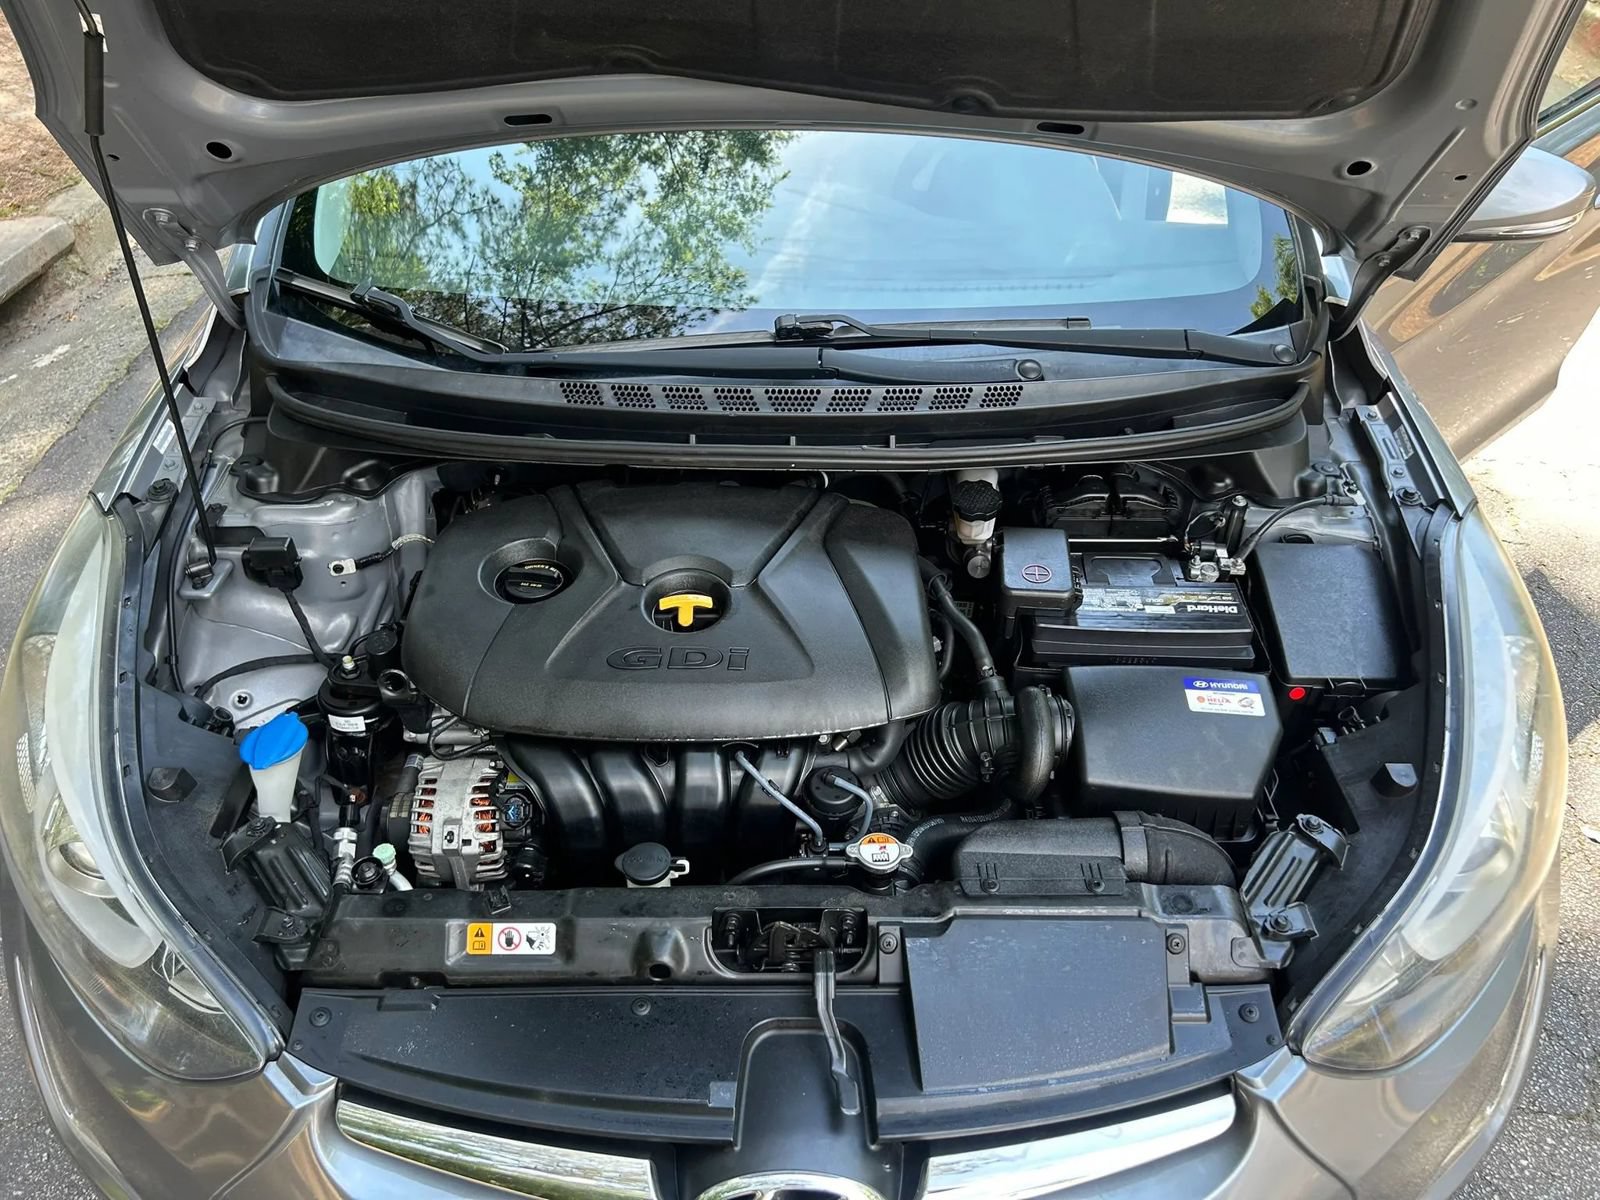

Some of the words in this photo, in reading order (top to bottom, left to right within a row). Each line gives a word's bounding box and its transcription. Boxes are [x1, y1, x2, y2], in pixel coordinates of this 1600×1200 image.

[1187, 604, 1239, 614] DieHard
[606, 646, 750, 671] GDi
[1209, 682, 1249, 690] HYUNDAI
